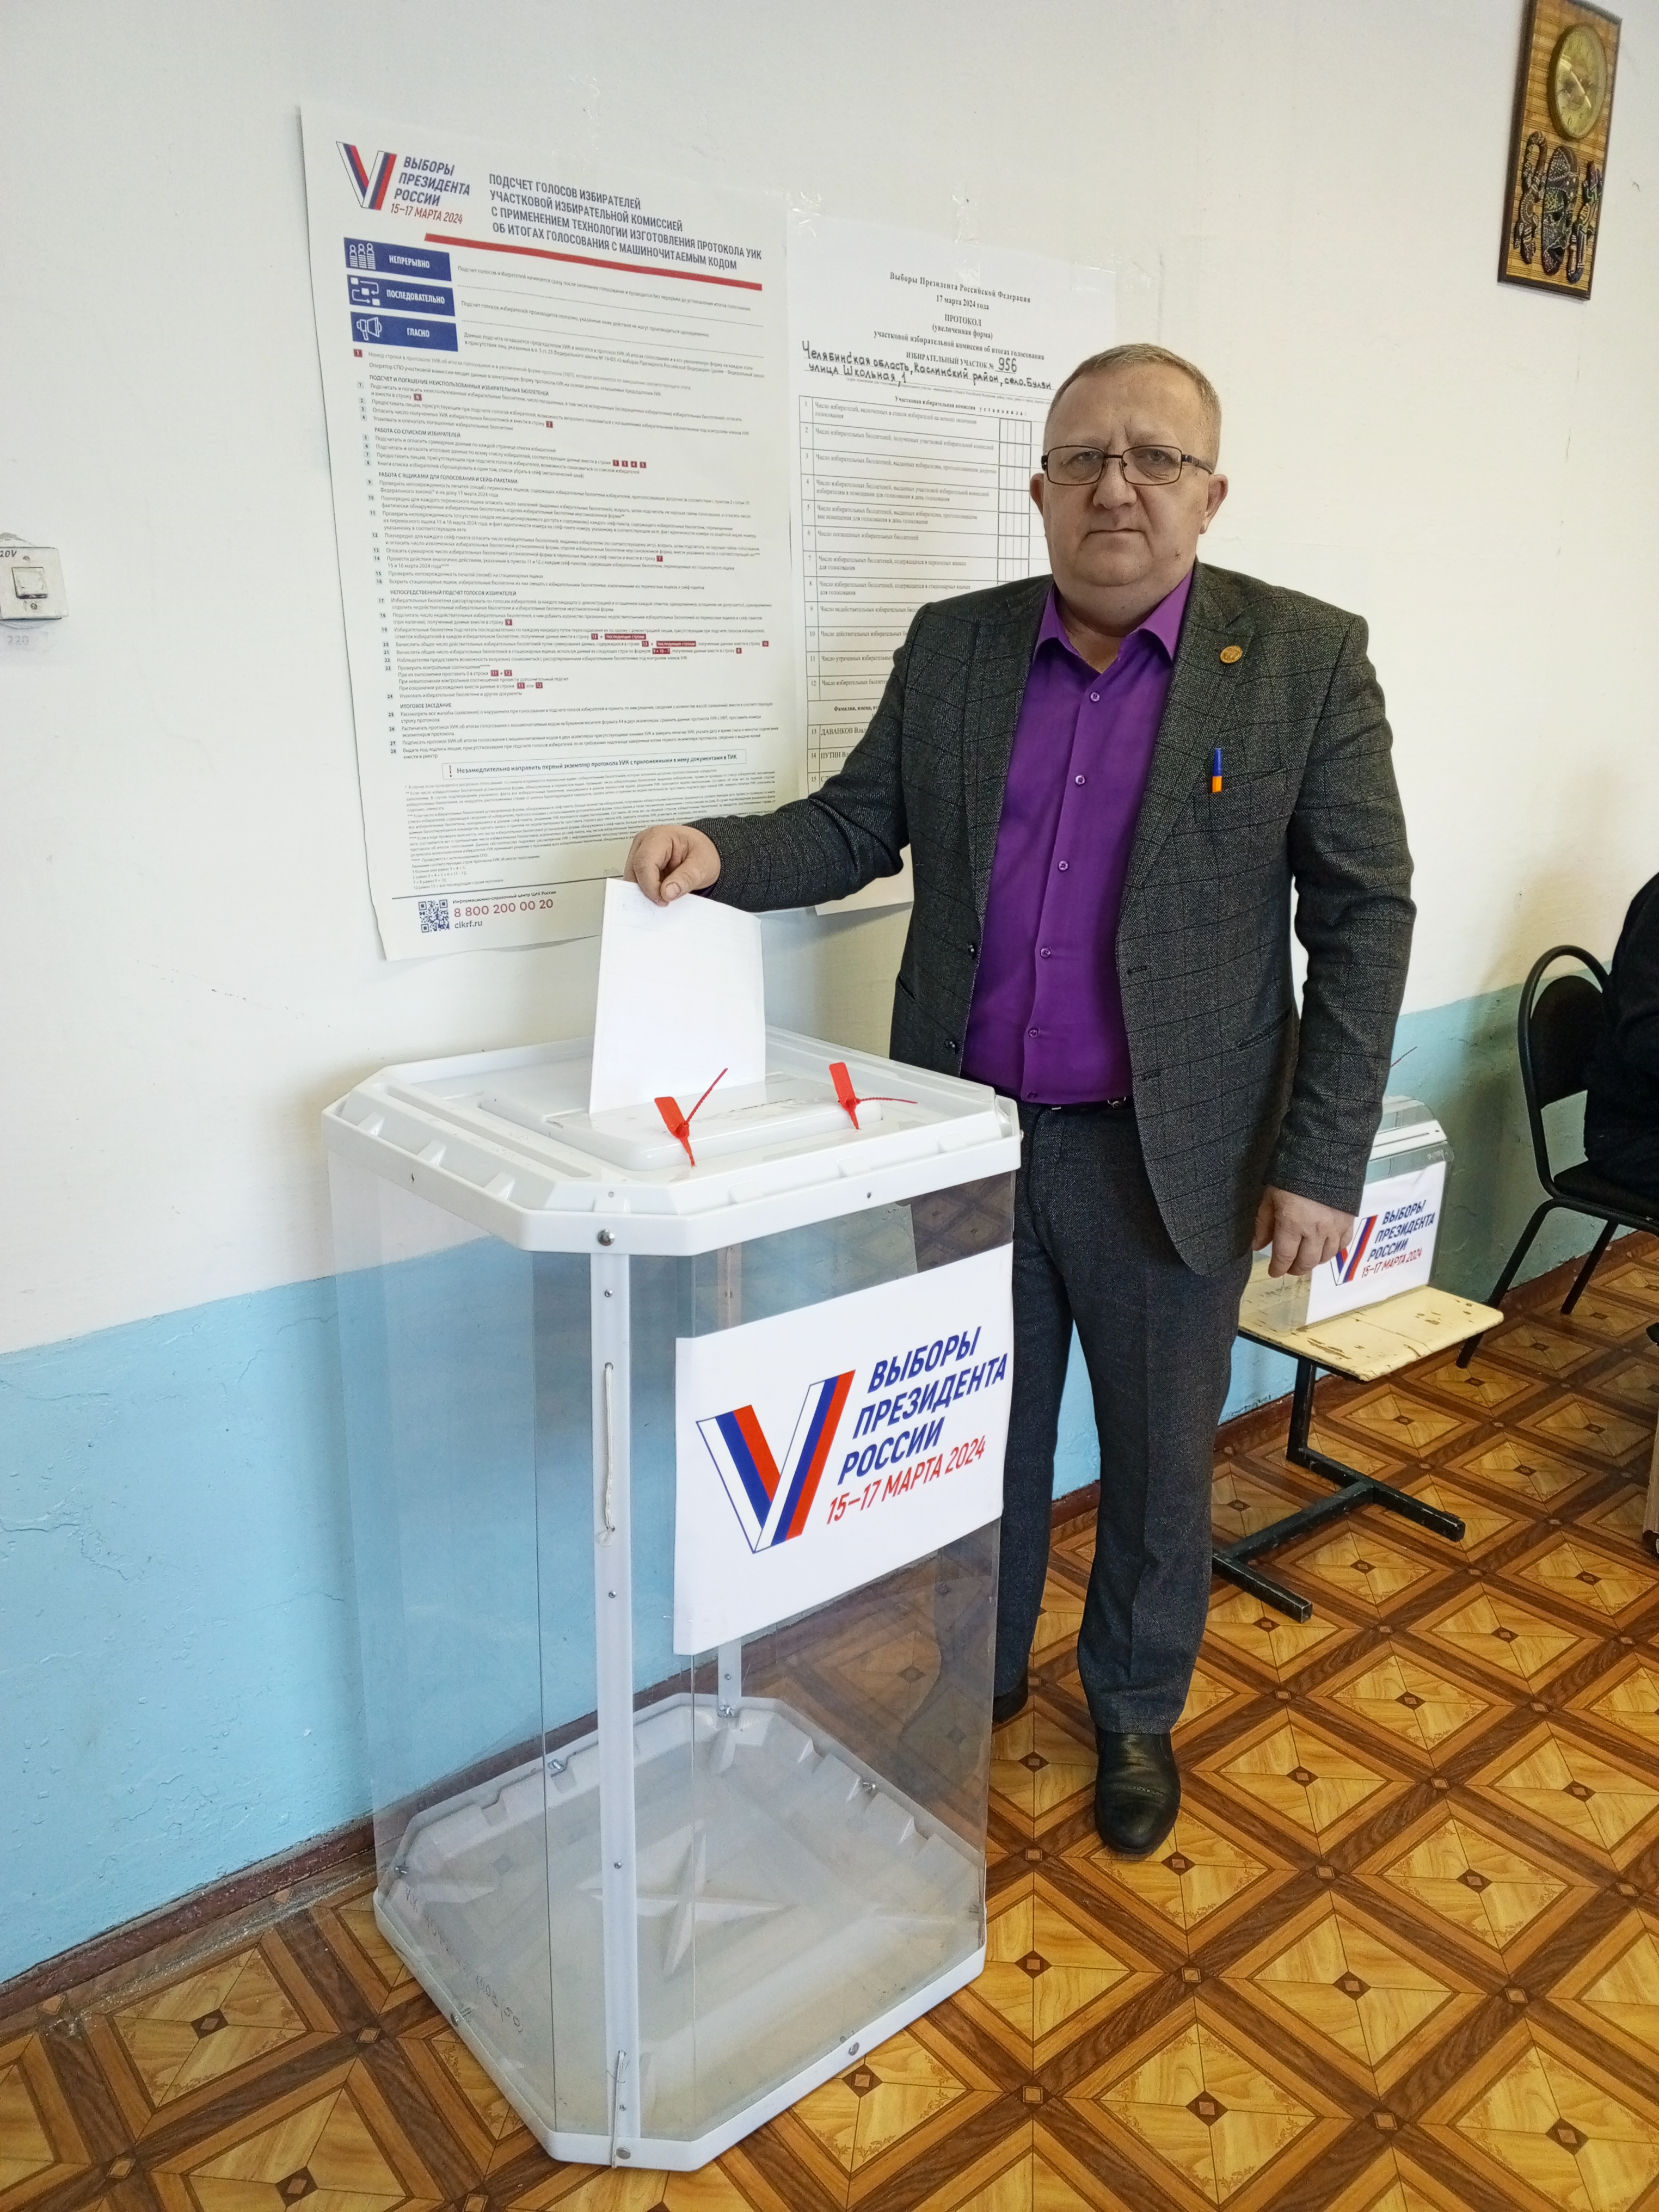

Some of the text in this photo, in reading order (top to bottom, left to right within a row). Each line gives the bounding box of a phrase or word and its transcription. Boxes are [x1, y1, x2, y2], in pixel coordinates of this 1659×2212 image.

[403, 156, 454, 176] ВЫБОРЫ
[398, 172, 470, 196] ПРЕЗИДЕНТА
[489, 173, 641, 210] ПОДСЧЕТ ГОЛОСОВ ИЗБИРАТЕЛЕЙ
[394, 188, 441, 206] РОССИИ
[414, 207, 441, 220] МАРТА
[444, 212, 463, 224] 2024
[489, 189, 683, 232] УЧАСТКОВОЙ ИЗБИРАТЕЛЬНОЙ КОМИССИЕЙ
[491, 206, 761, 260] С ПРИМЕНЕНИЕМ ТЕХНОЛОГИИ ИЗГОТОВЛЕНИЯ ПРОТОКОЛА УИК
[493, 222, 737, 270] ОБ ИТОГАХ ГОЛОСОВАНИЯ С МАШИНОЧИТАЕМЫМ КОДОМ
[389, 255, 430, 268] НЕПРЕРЫВНО
[386, 289, 445, 304] ПОСЛЕДОВАТЕЛЬНО
[890, 272, 1030, 303] Выборы Президента Российской Федерации
[944, 297, 962, 306] марта
[963, 299, 975, 308] 2024
[407, 327, 430, 337] ГЛАСНО
[932, 323, 993, 340] (увеличенная форма)
[944, 314, 981, 327] ПРОТОКОЛ
[874, 331, 908, 341] участковой
[910, 335, 954, 347] избирательной
[956, 342, 982, 352] комиссии
[1011, 351, 1044, 360] голосования
[802, 340, 870, 365] Челябинская
[914, 362, 968, 379] Каслинский
[906, 351, 960, 365] ИЗБИРАТЕЛЬНЫЙ
[960, 359, 987, 368] УЧАСТОК
[998, 357, 1017, 372] 956
[429, 380, 481, 389] НЕИСПОЛЬЗОВАННЫХ
[895, 396, 921, 404] Участковая
[922, 400, 954, 408] избирательная
[821, 728, 853, 736] ДАВАНКОВ
[452, 894, 517, 904] Информационно-справочный
[454, 899, 553, 918] 8 800 200 00 20
[1382, 1200, 1427, 1225] ВЫБОРЫ
[1375, 1212, 1435, 1244] ПРЕЗИДЕНТА
[1367, 1238, 1409, 1262] РОССИИ
[1381, 1253, 1406, 1271] МАРТА
[1405, 1247, 1422, 1263] 2024
[867, 1325, 982, 1393] ВЫБОРЫ
[852, 1353, 1007, 1440] ПРЕЗИДЕНТА
[837, 1416, 945, 1486] РОССИИ
[826, 1435, 986, 1525] 15–17 МАРТА 2024
